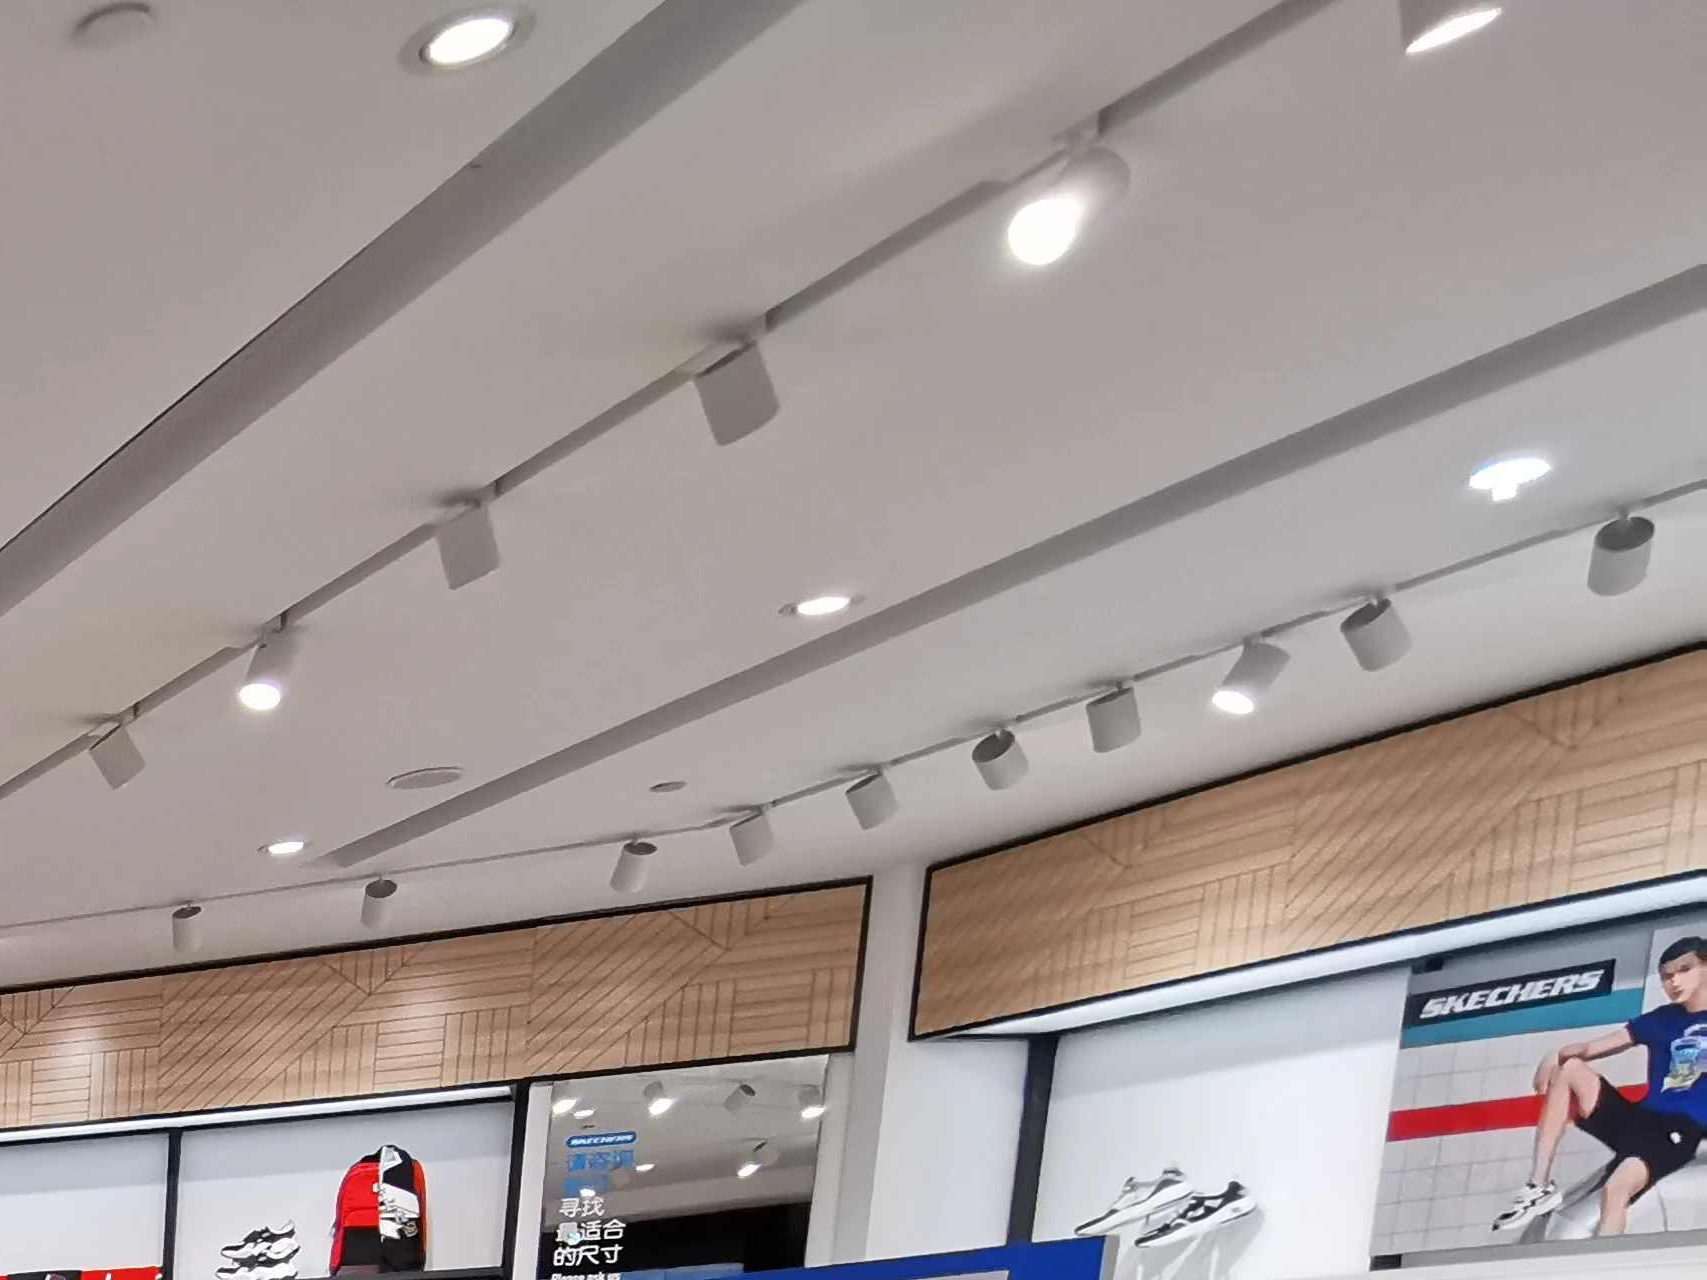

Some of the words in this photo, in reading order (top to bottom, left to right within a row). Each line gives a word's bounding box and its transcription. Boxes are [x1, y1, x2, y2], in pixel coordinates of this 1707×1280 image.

[1419, 968, 1605, 1019] SKECHERS
[558, 1197, 606, 1218] 寻找
[553, 1244, 624, 1267] 的尺寸
